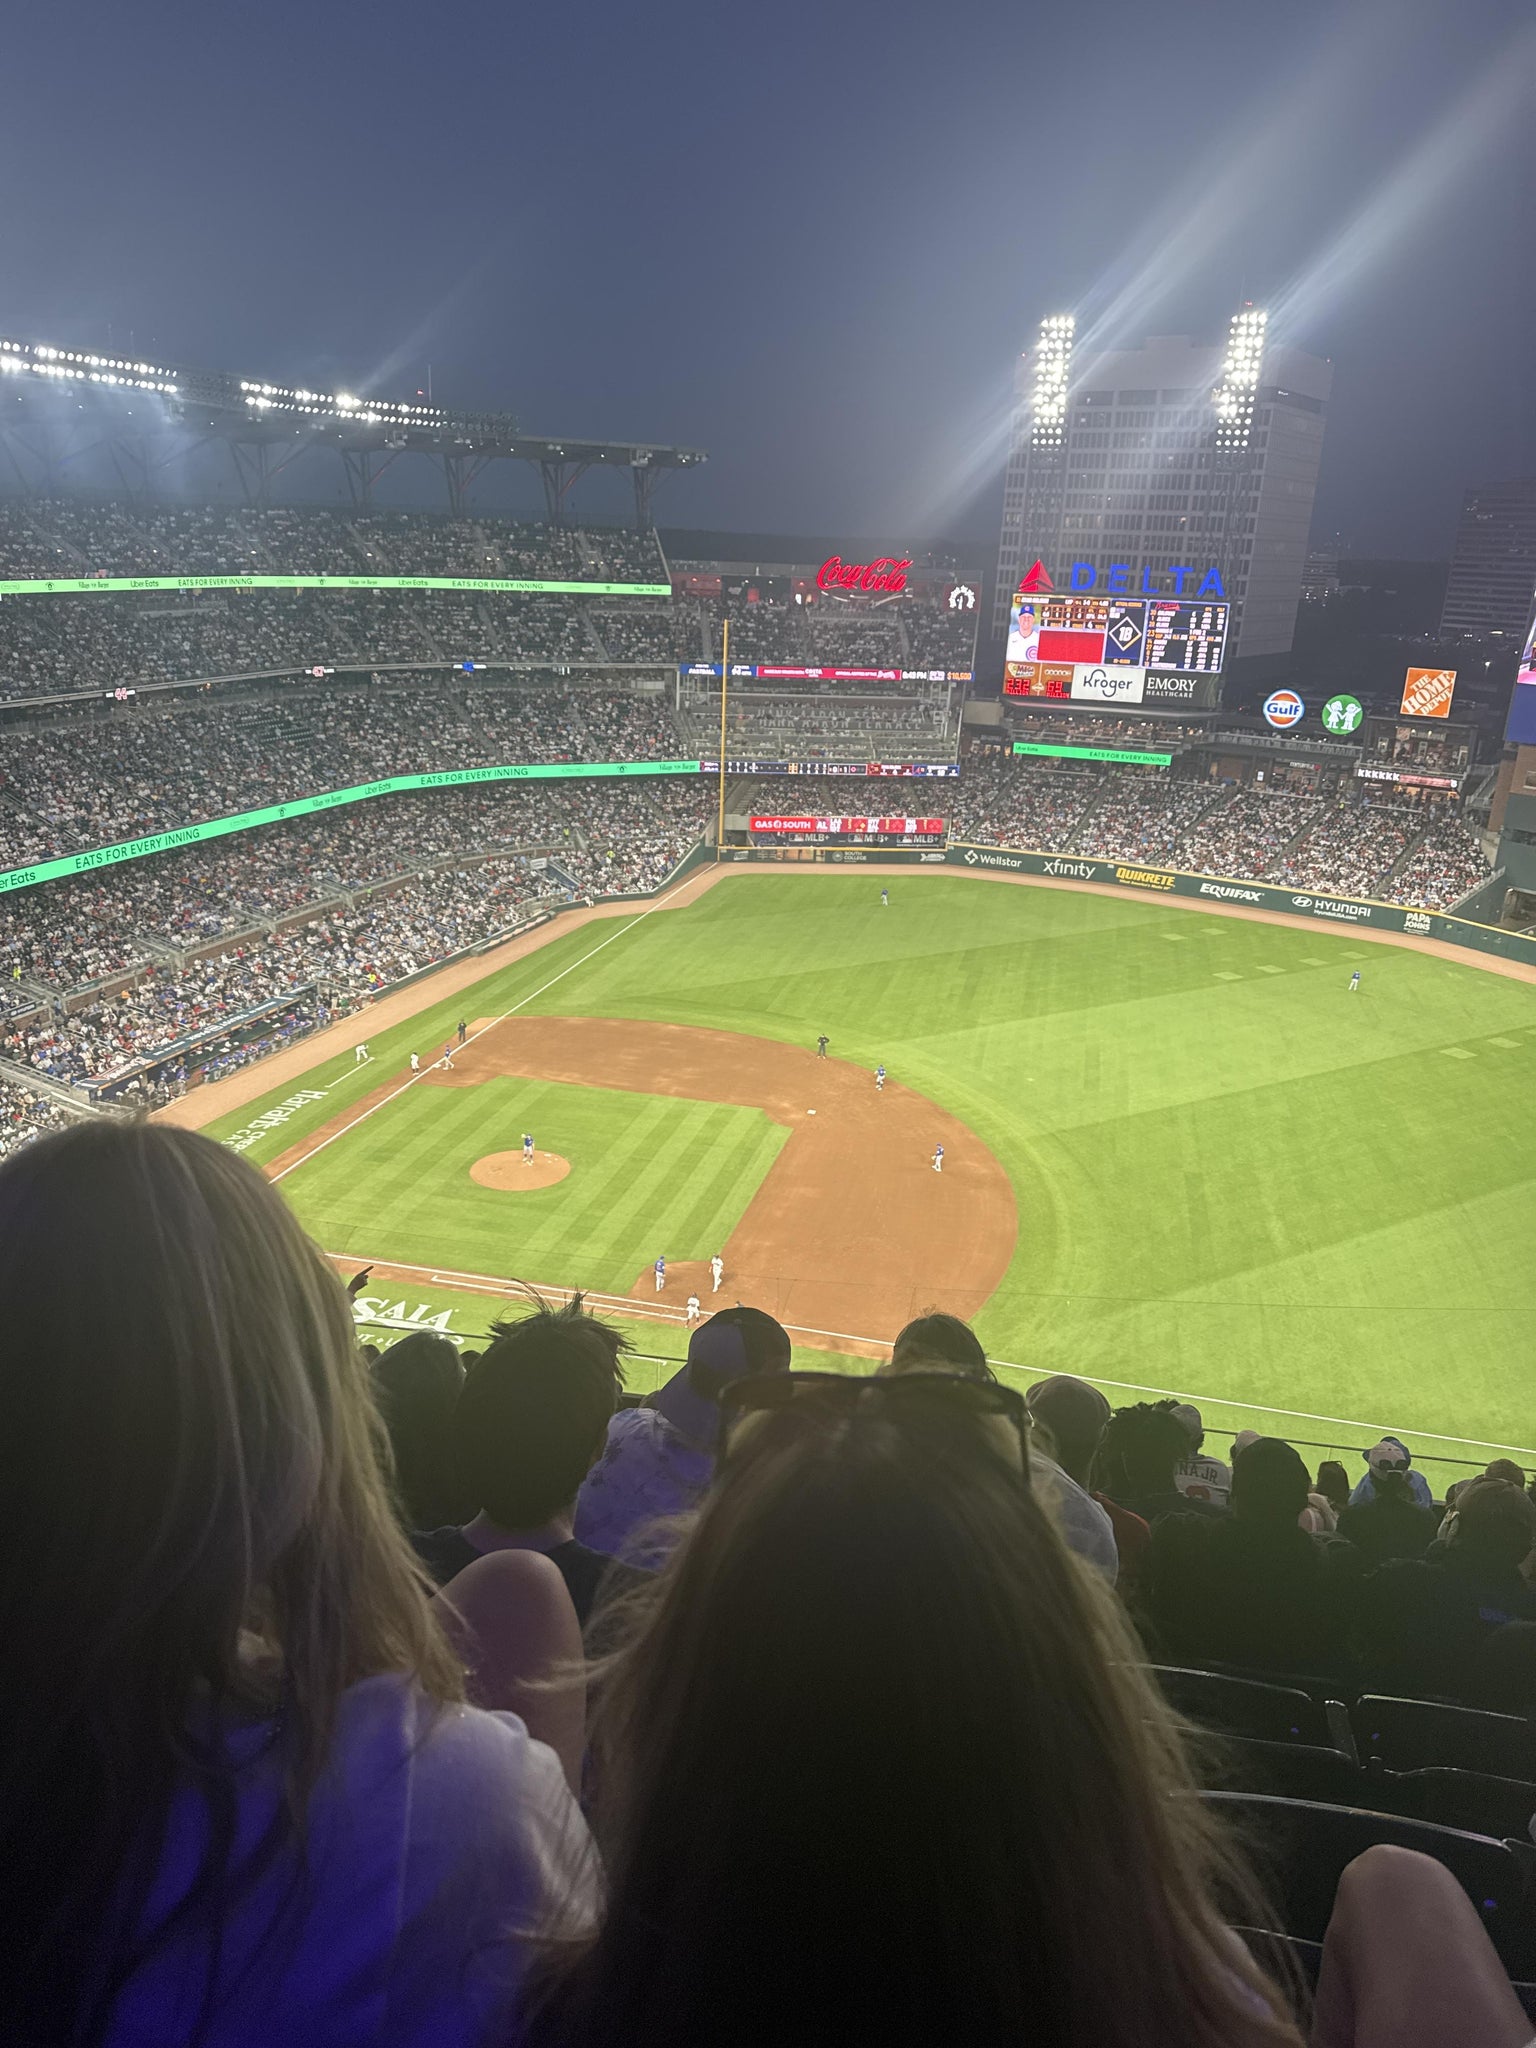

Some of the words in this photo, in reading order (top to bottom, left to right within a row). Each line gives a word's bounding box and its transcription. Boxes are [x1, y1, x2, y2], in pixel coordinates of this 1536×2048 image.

[145, 580, 159, 588] Eats
[177, 579, 194, 587] EATS
[209, 578, 228, 586] EVERY
[229, 577, 253, 585] INNING
[413, 579, 429, 587] Eats
[491, 581, 514, 589] EVERY
[516, 582, 544, 590] INNING
[1070, 562, 1225, 597] DELTA
[1083, 669, 1133, 698] Kroger
[1146, 677, 1198, 692] EMORY
[1410, 674, 1431, 692] THE
[1146, 690, 1193, 698] HEALTHCARE
[1402, 671, 1455, 714] HOME
[1420, 688, 1452, 715] DEPOT
[1267, 703, 1300, 715] Gulf
[420, 775, 443, 785] EATS
[445, 773, 463, 782] FOR
[465, 770, 492, 780] EVERY
[494, 768, 528, 777] INNING
[364, 786, 378, 795] Uber
[378, 782, 392, 792] Eats
[755, 820, 773, 829] GAS
[783, 821, 811, 829] SOUTH
[805, 833, 830, 842] MLB+
[864, 834, 889, 843] MB+
[913, 834, 939, 843] MLB+
[75, 855, 103, 869] EATS
[106, 848, 128, 862] FOR
[130, 839, 163, 855] EVERY
[164, 828, 200, 846] INNING
[980, 854, 1022, 868] Wellstar
[1043, 859, 1096, 879] xfinity
[10, 871, 36, 886] Eats
[1116, 867, 1175, 886] QUIKRETE
[1200, 883, 1262, 902] EQUIFAX
[1315, 900, 1371, 917] HYUNDAI
[1406, 913, 1431, 923] PAPA
[1404, 921, 1430, 931] JOHNS
[352, 1297, 453, 1329] SAIA
